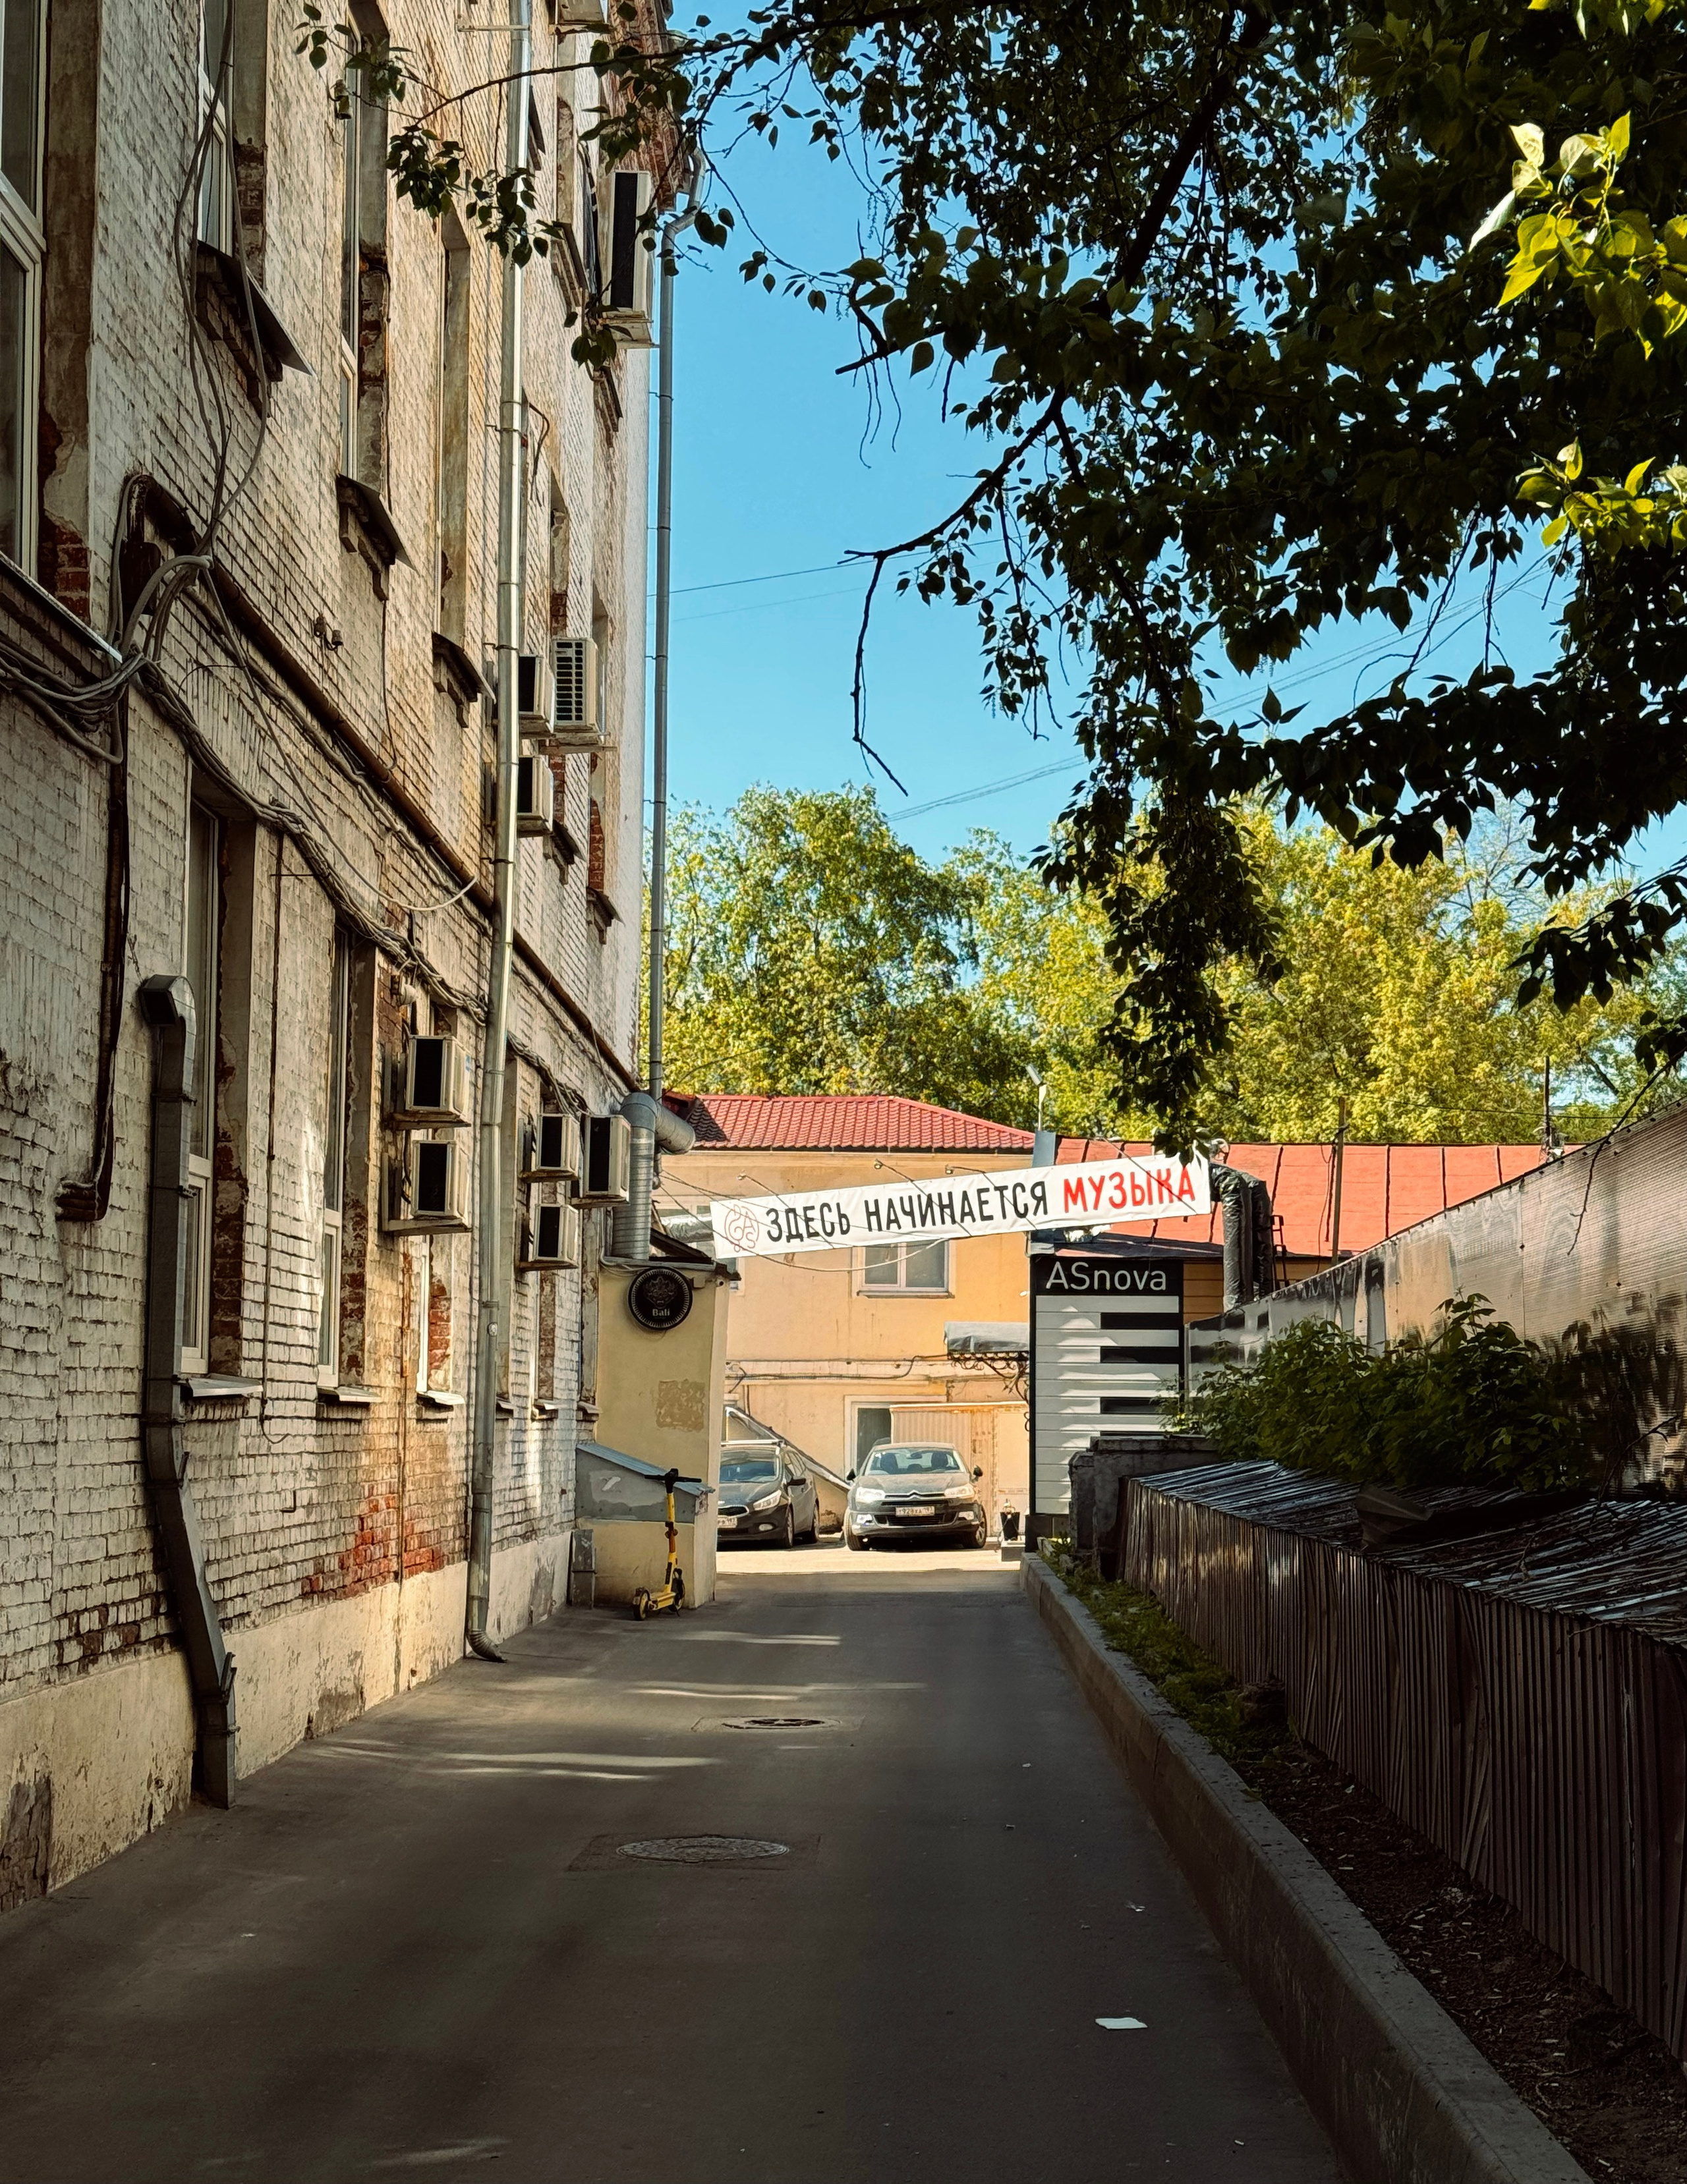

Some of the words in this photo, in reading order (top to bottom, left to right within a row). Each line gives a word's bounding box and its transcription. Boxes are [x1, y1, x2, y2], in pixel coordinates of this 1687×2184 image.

[765, 1202, 851, 1243] ЗДЕСЬ
[864, 1181, 1048, 1232] НАЧИНАЕТСЯ
[1063, 1166, 1195, 1214] МУЗЫКА
[1045, 1261, 1166, 1291] ASnova
[652, 1308, 670, 1316] Bali
